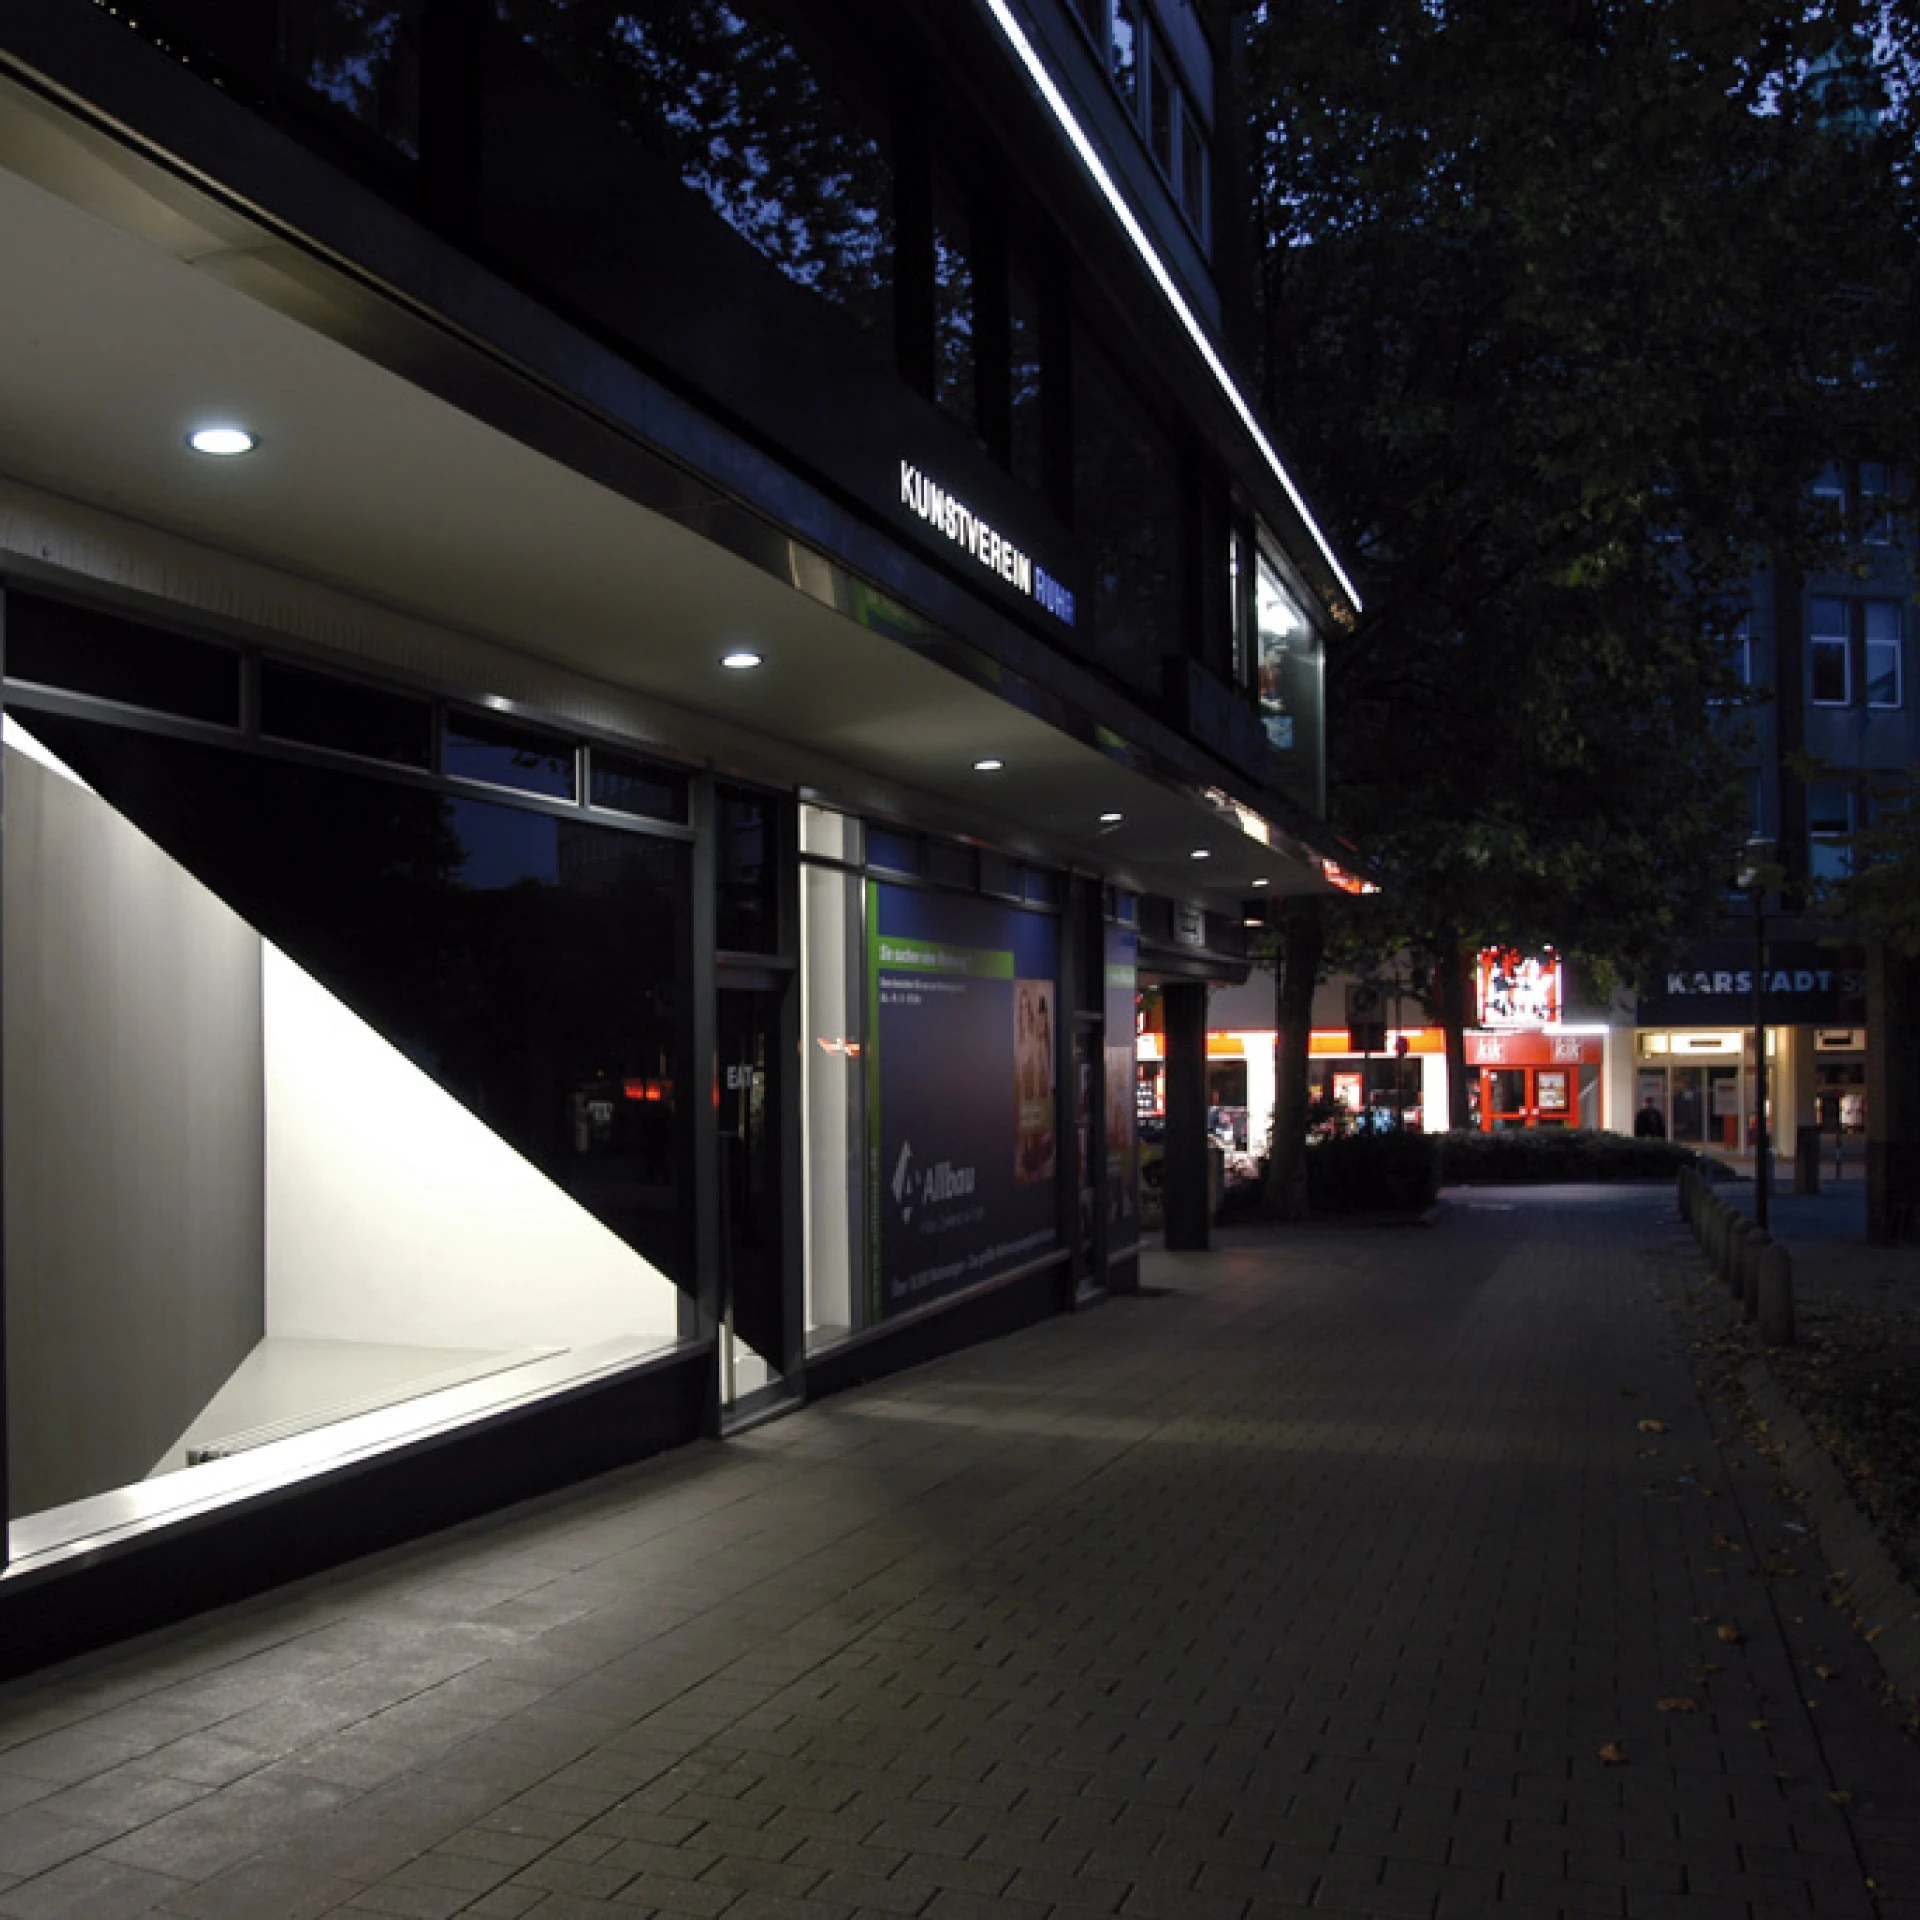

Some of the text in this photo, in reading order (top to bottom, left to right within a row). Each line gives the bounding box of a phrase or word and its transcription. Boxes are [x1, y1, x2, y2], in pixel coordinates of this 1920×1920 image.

[900, 459, 1032, 596] KUNSTVEREIN
[1667, 968, 1833, 994] KARSTADT
[922, 1161, 976, 1204] Allbau
